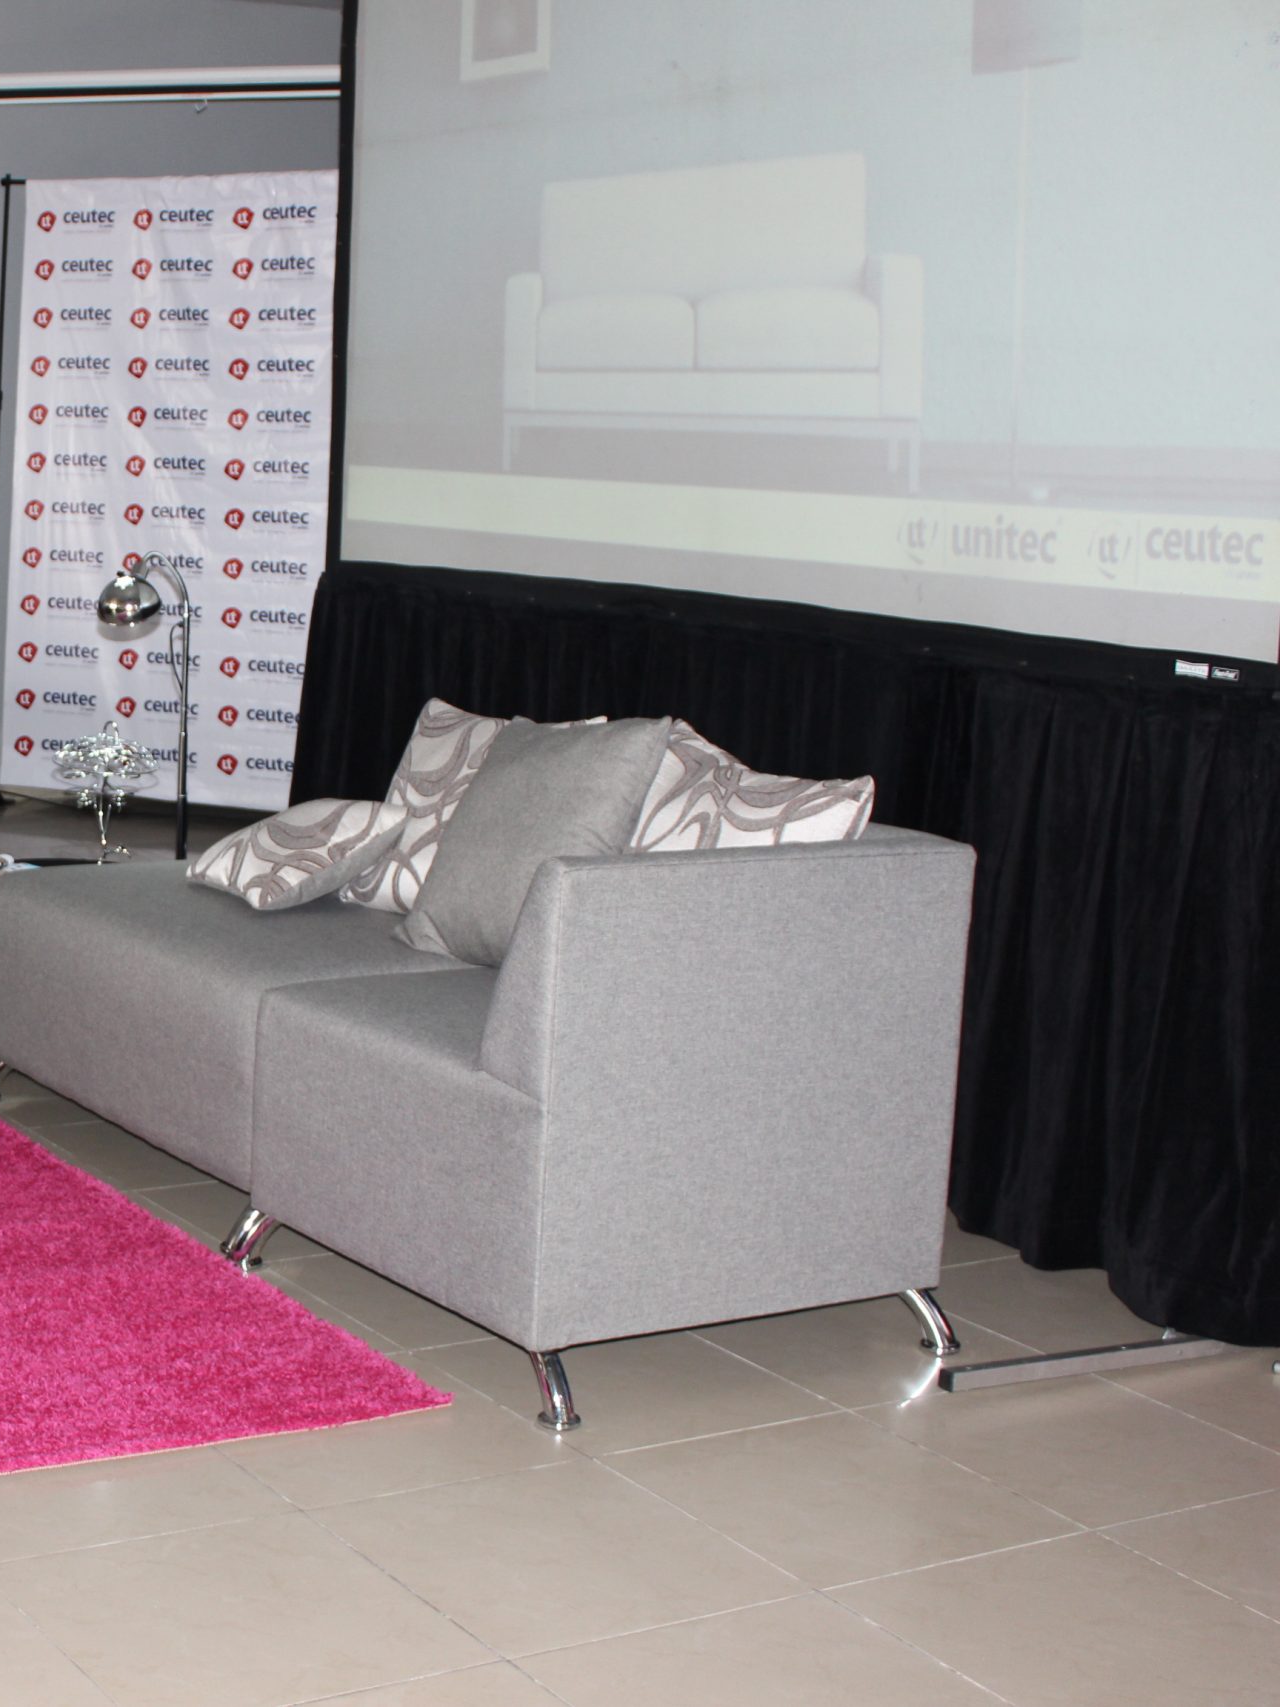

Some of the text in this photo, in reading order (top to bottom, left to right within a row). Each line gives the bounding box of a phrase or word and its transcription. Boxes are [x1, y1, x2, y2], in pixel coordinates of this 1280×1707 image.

[63, 210, 115, 224] ceutec
[159, 208, 214, 222] ceutec
[263, 204, 317, 220] ceutec
[61, 259, 112, 272] ceutec
[160, 258, 213, 272] ceutec
[261, 256, 315, 271] ceutec
[60, 307, 112, 321] ceutec
[159, 307, 209, 322] ceutec
[258, 307, 313, 321] ceutec
[58, 356, 110, 369] ceutec
[155, 357, 210, 372] ceutec
[257, 358, 313, 372] ceutec
[56, 404, 108, 418] ceutec
[154, 407, 208, 421] ceutec
[257, 409, 311, 423] ceutec
[54, 453, 107, 467] ceutec
[154, 456, 205, 471] ceutec
[253, 460, 308, 474] ceutec
[52, 502, 105, 515] ceutec
[151, 505, 205, 520] ceutec
[252, 511, 307, 524] ceutec
[951, 513, 1057, 564] unitec
[1145, 525, 1264, 566] ceutec
[50, 549, 103, 564] ceutec
[251, 560, 307, 575] ceutec
[249, 610, 304, 625] ceutec
[45, 645, 98, 659] ceutec
[43, 691, 96, 707] ceutec
[144, 699, 198, 715] ceutc
[246, 757, 294, 772] ceute
